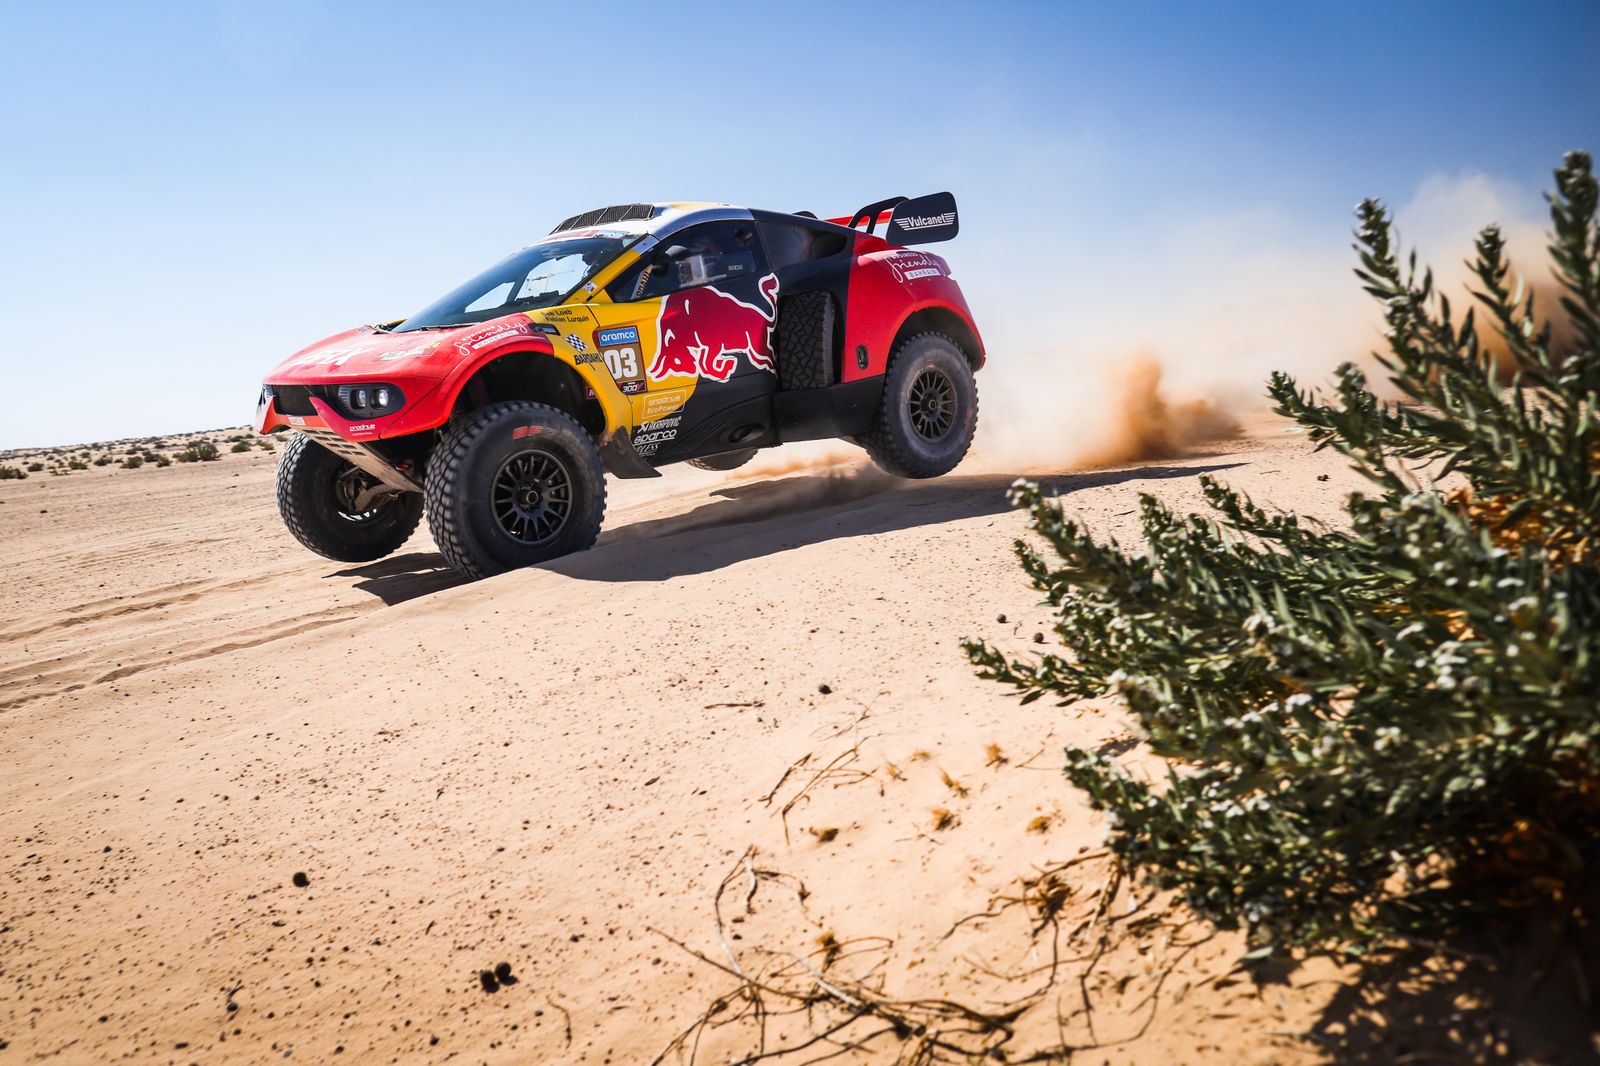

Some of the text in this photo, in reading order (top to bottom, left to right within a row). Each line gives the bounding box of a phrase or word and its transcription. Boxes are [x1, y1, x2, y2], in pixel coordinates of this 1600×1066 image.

[907, 213, 946, 227] Vulcanet
[909, 269, 938, 278] BAHRAIN
[567, 315, 589, 323] Lurquin
[601, 332, 635, 341] aramco
[574, 352, 603, 366] BARDAHL
[603, 347, 638, 380] 03
[634, 429, 677, 445] sparco
